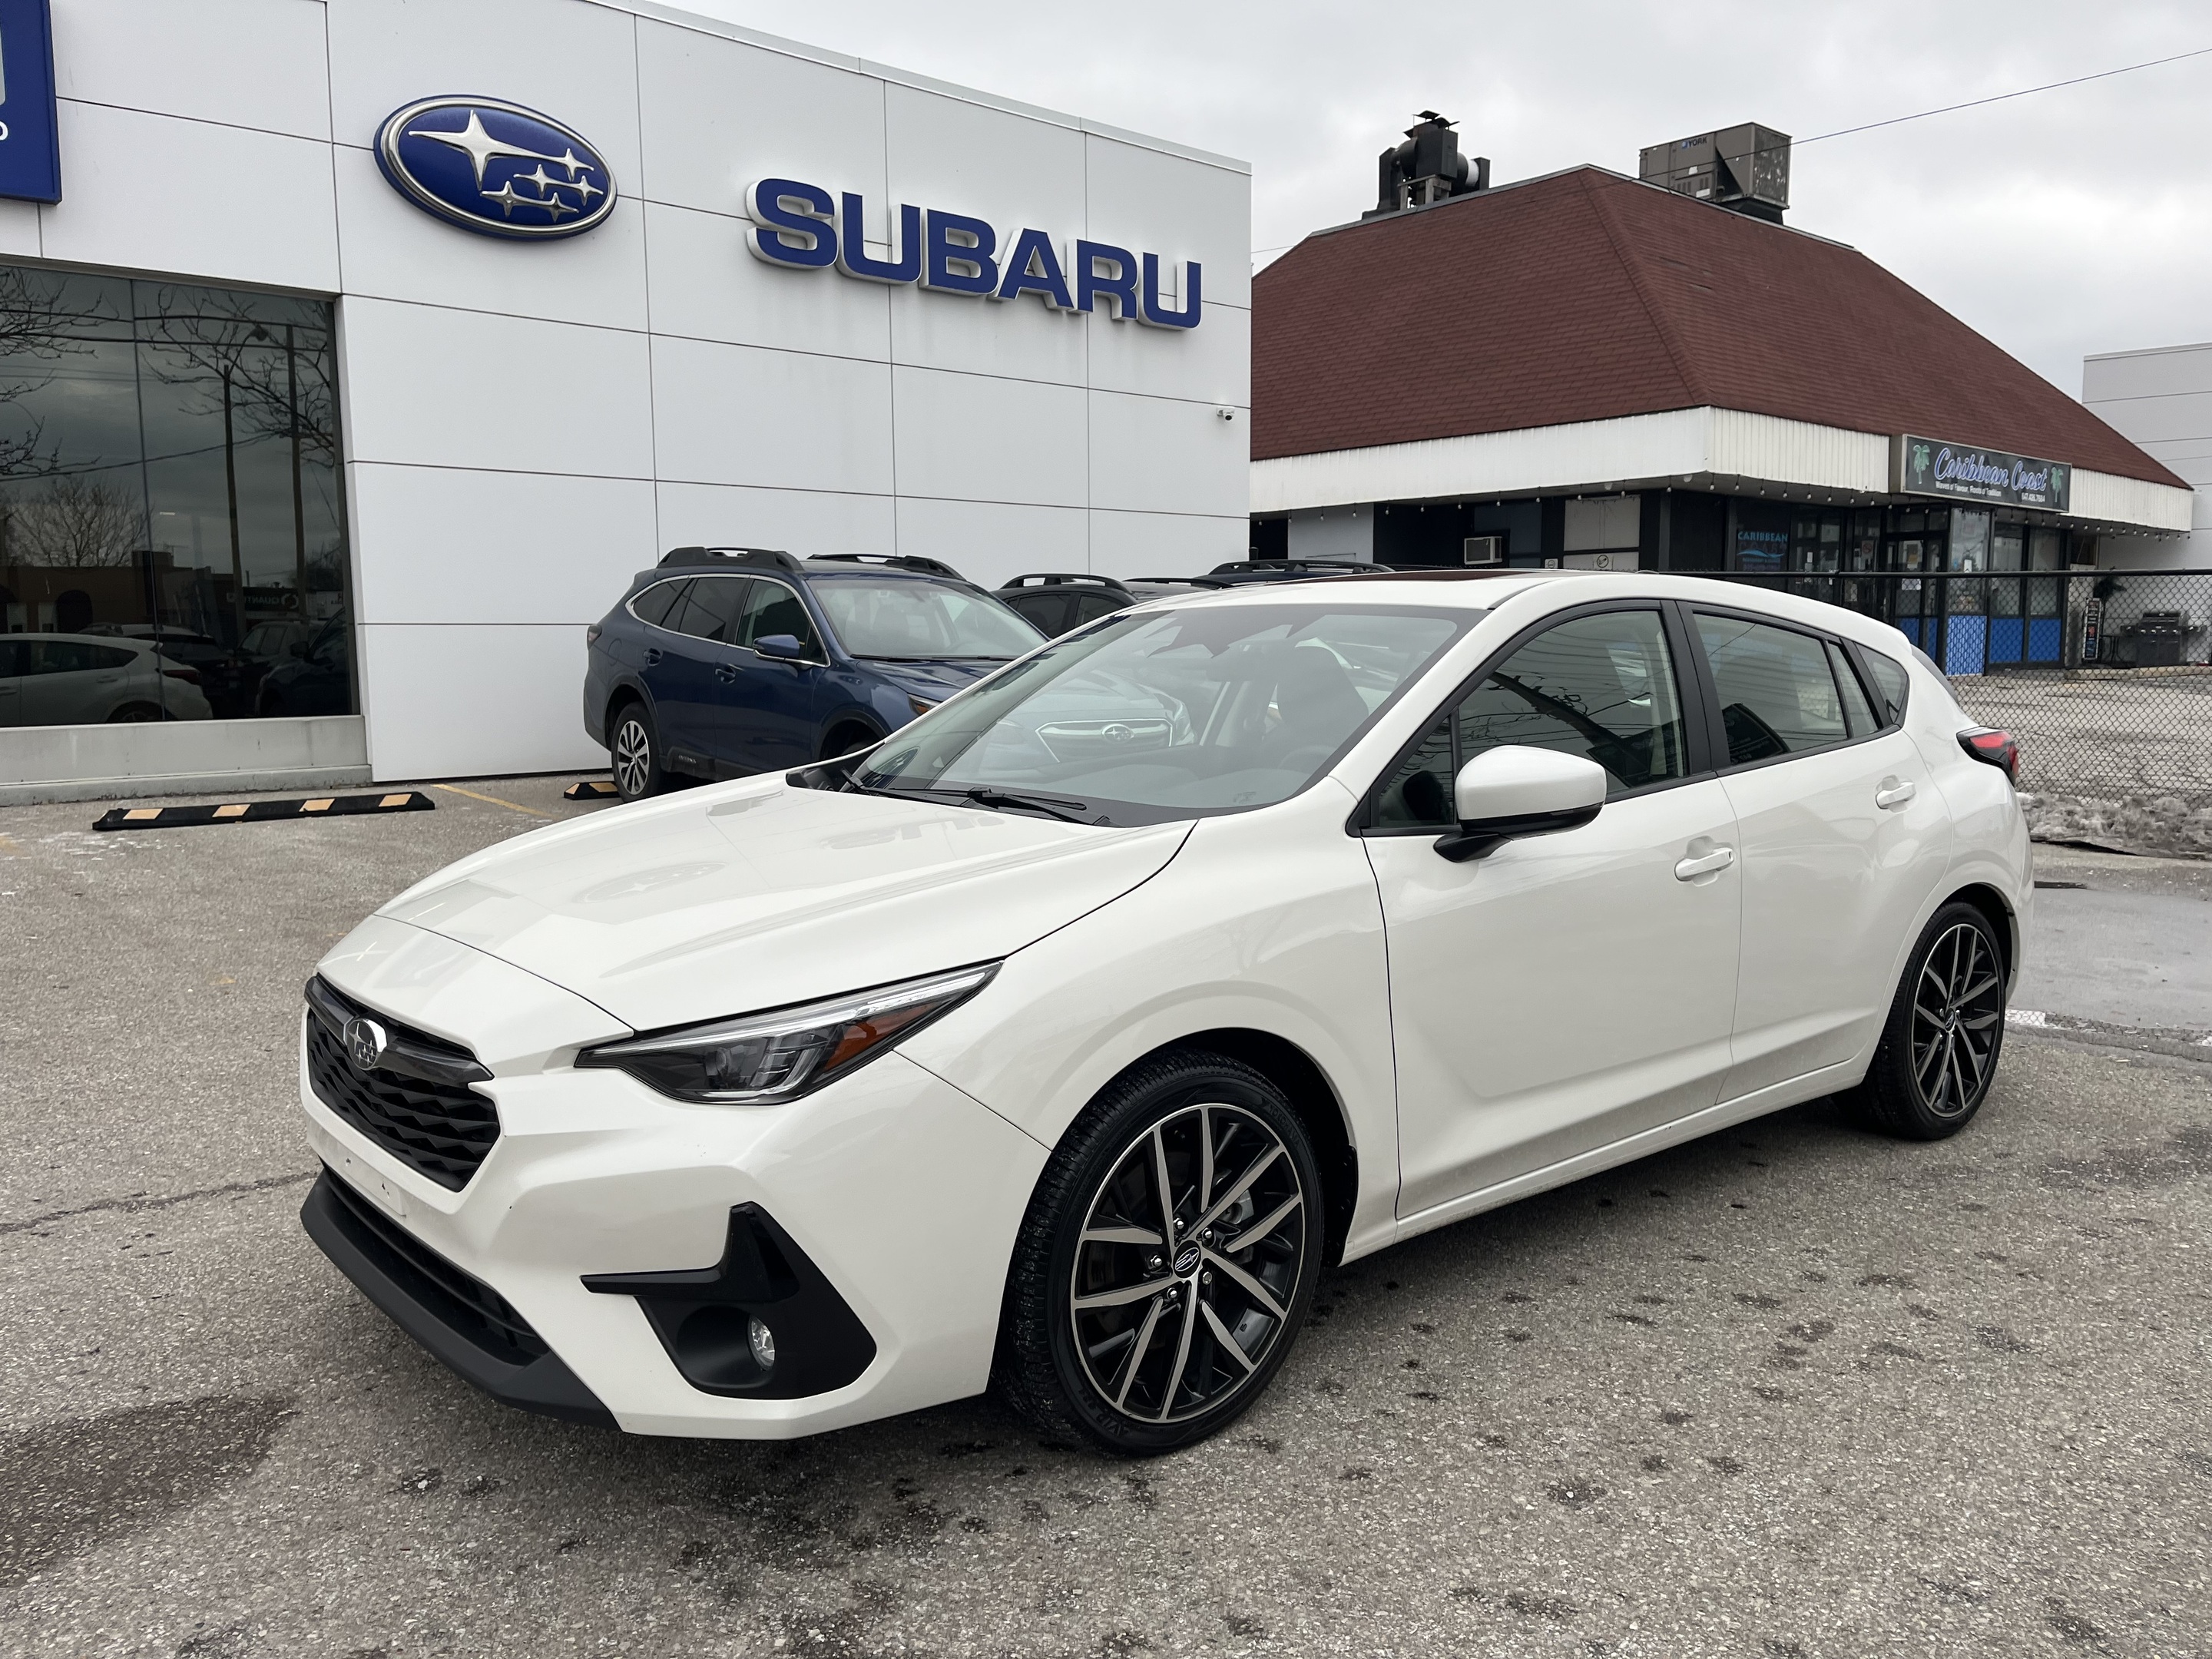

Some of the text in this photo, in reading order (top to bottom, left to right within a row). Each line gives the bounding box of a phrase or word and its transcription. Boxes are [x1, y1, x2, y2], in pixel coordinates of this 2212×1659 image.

[1688, 136, 1707, 147] YORK
[747, 177, 1202, 330] SUBARU
[1934, 447, 2048, 491] Caribbean Coast
[1737, 531, 1789, 542] CARIBBEAN
